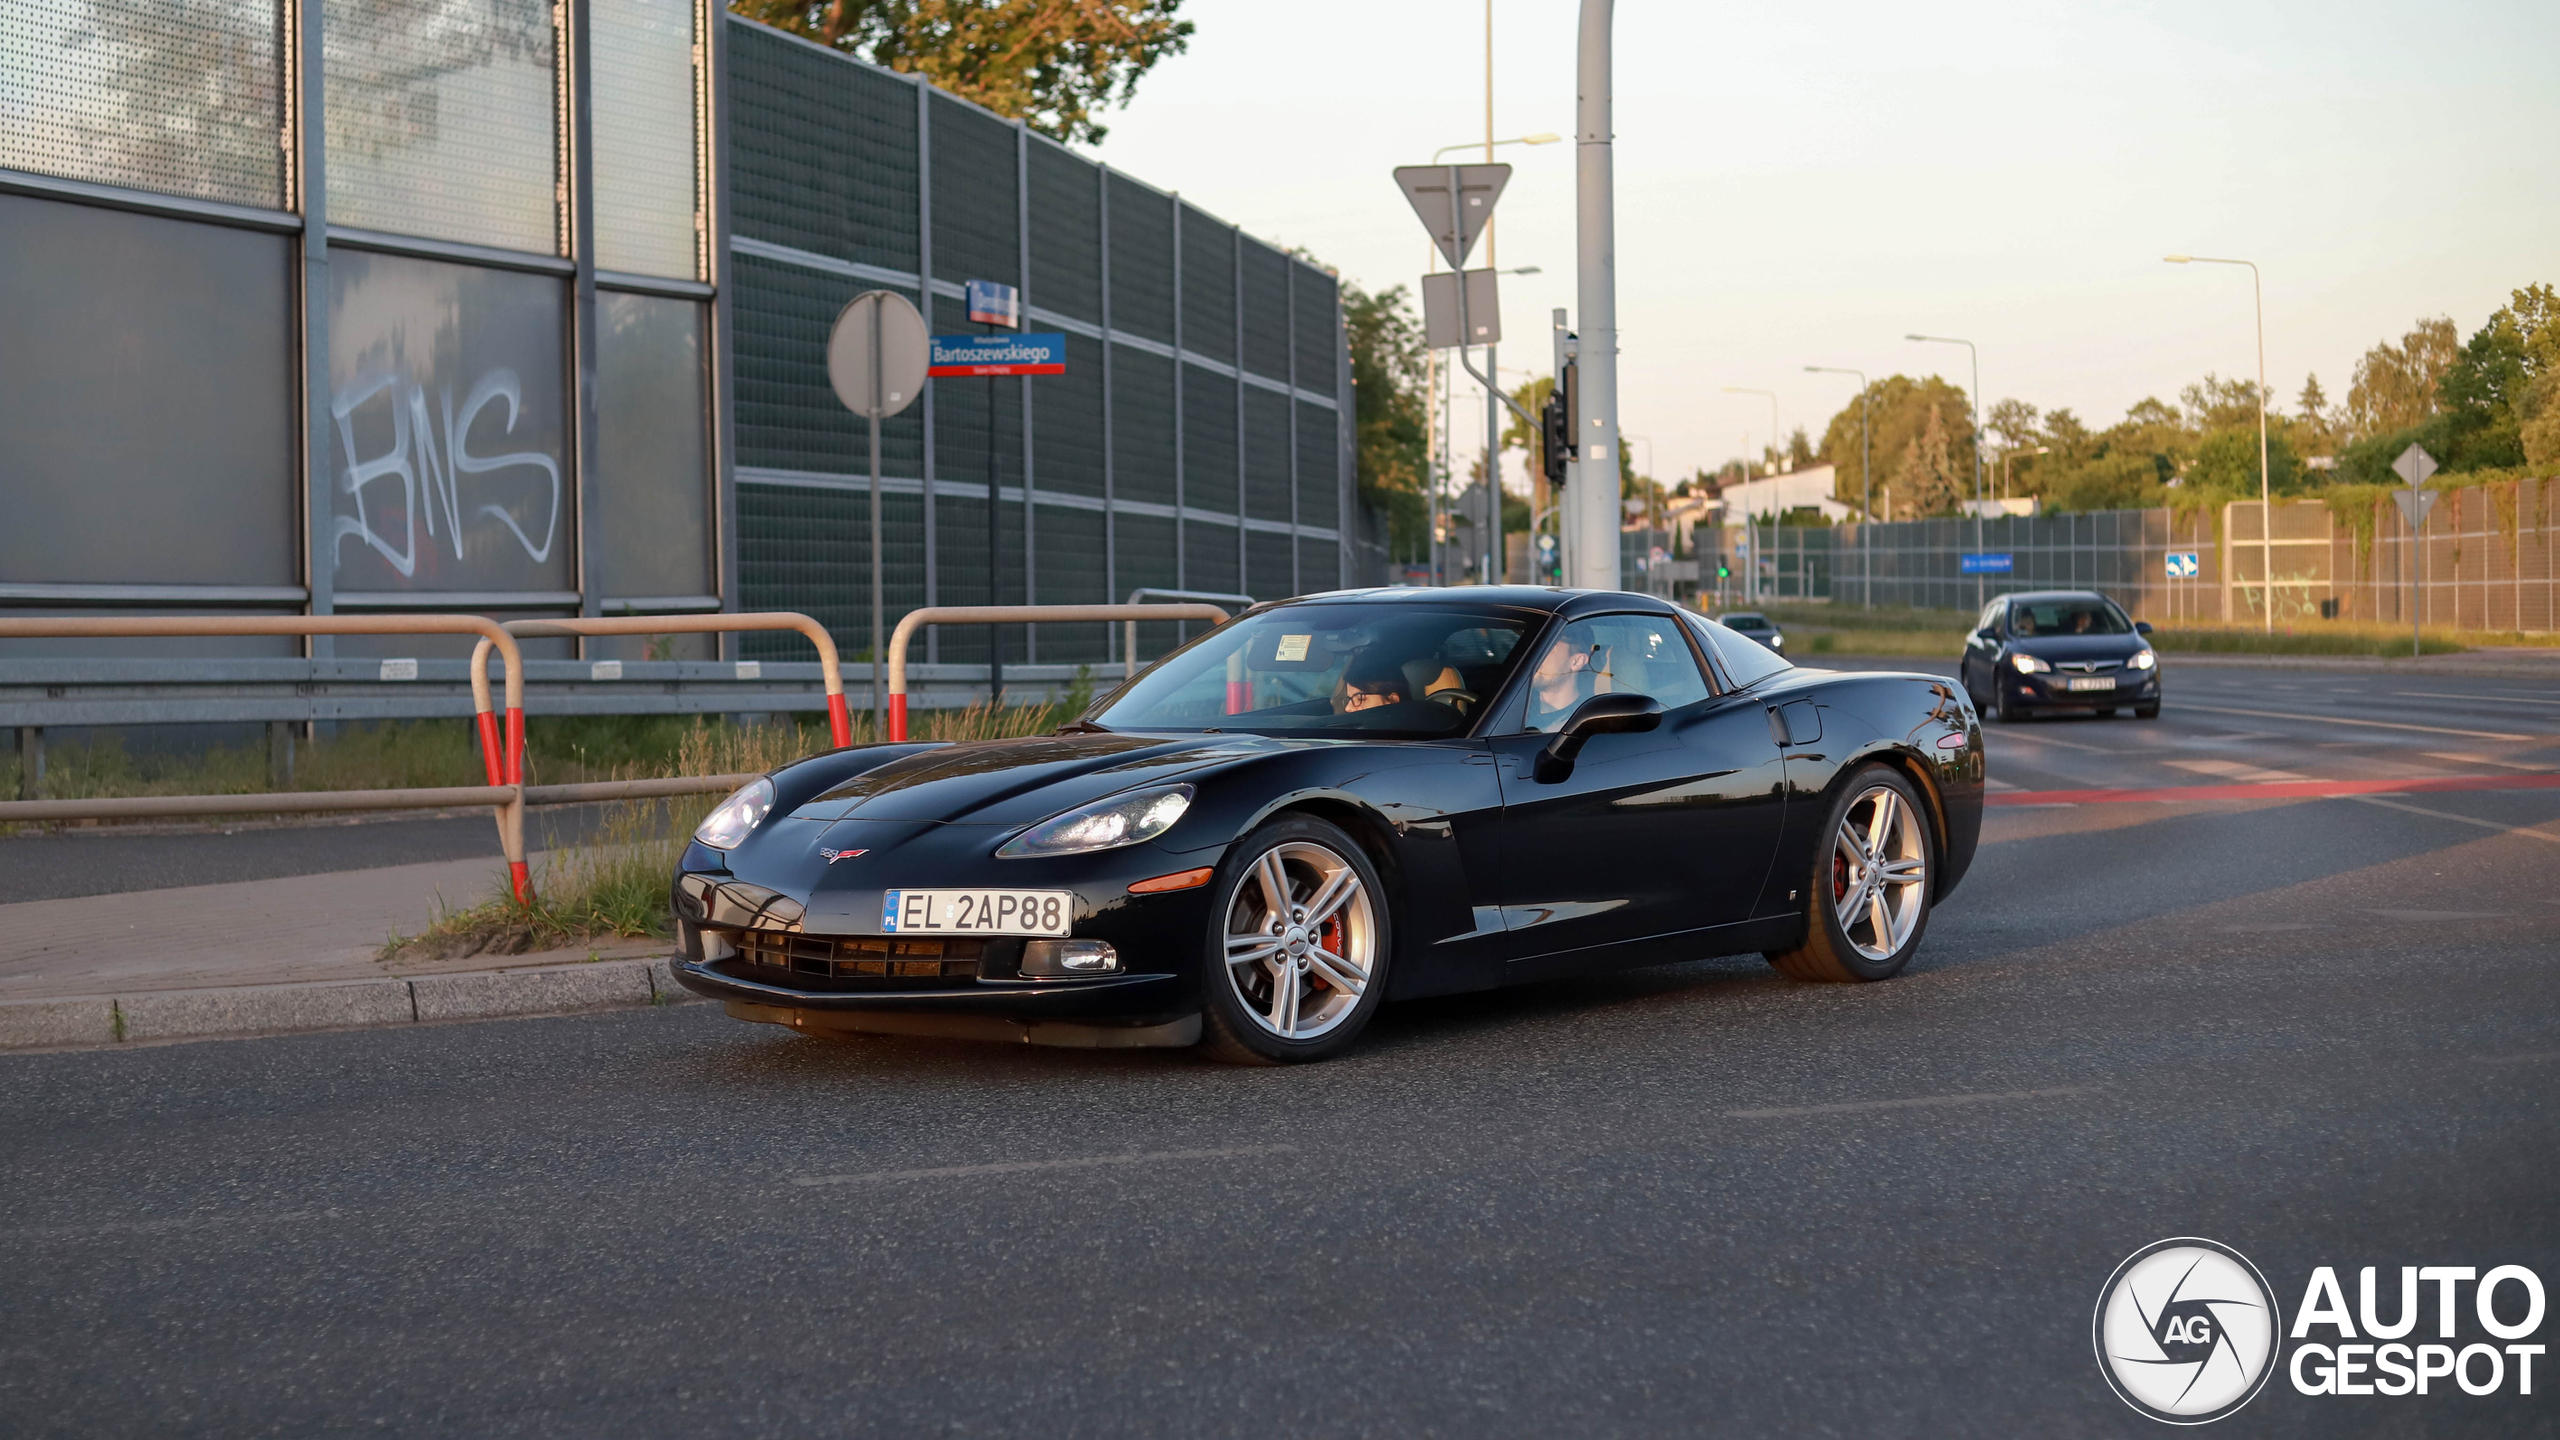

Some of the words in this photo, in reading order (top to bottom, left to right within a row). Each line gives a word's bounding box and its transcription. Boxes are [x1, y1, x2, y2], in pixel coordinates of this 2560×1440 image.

[934, 344, 1050, 364] Bartoszewskiego
[885, 916, 896, 926] PL
[903, 895, 941, 929] EL
[955, 895, 1061, 931] 2AP88
